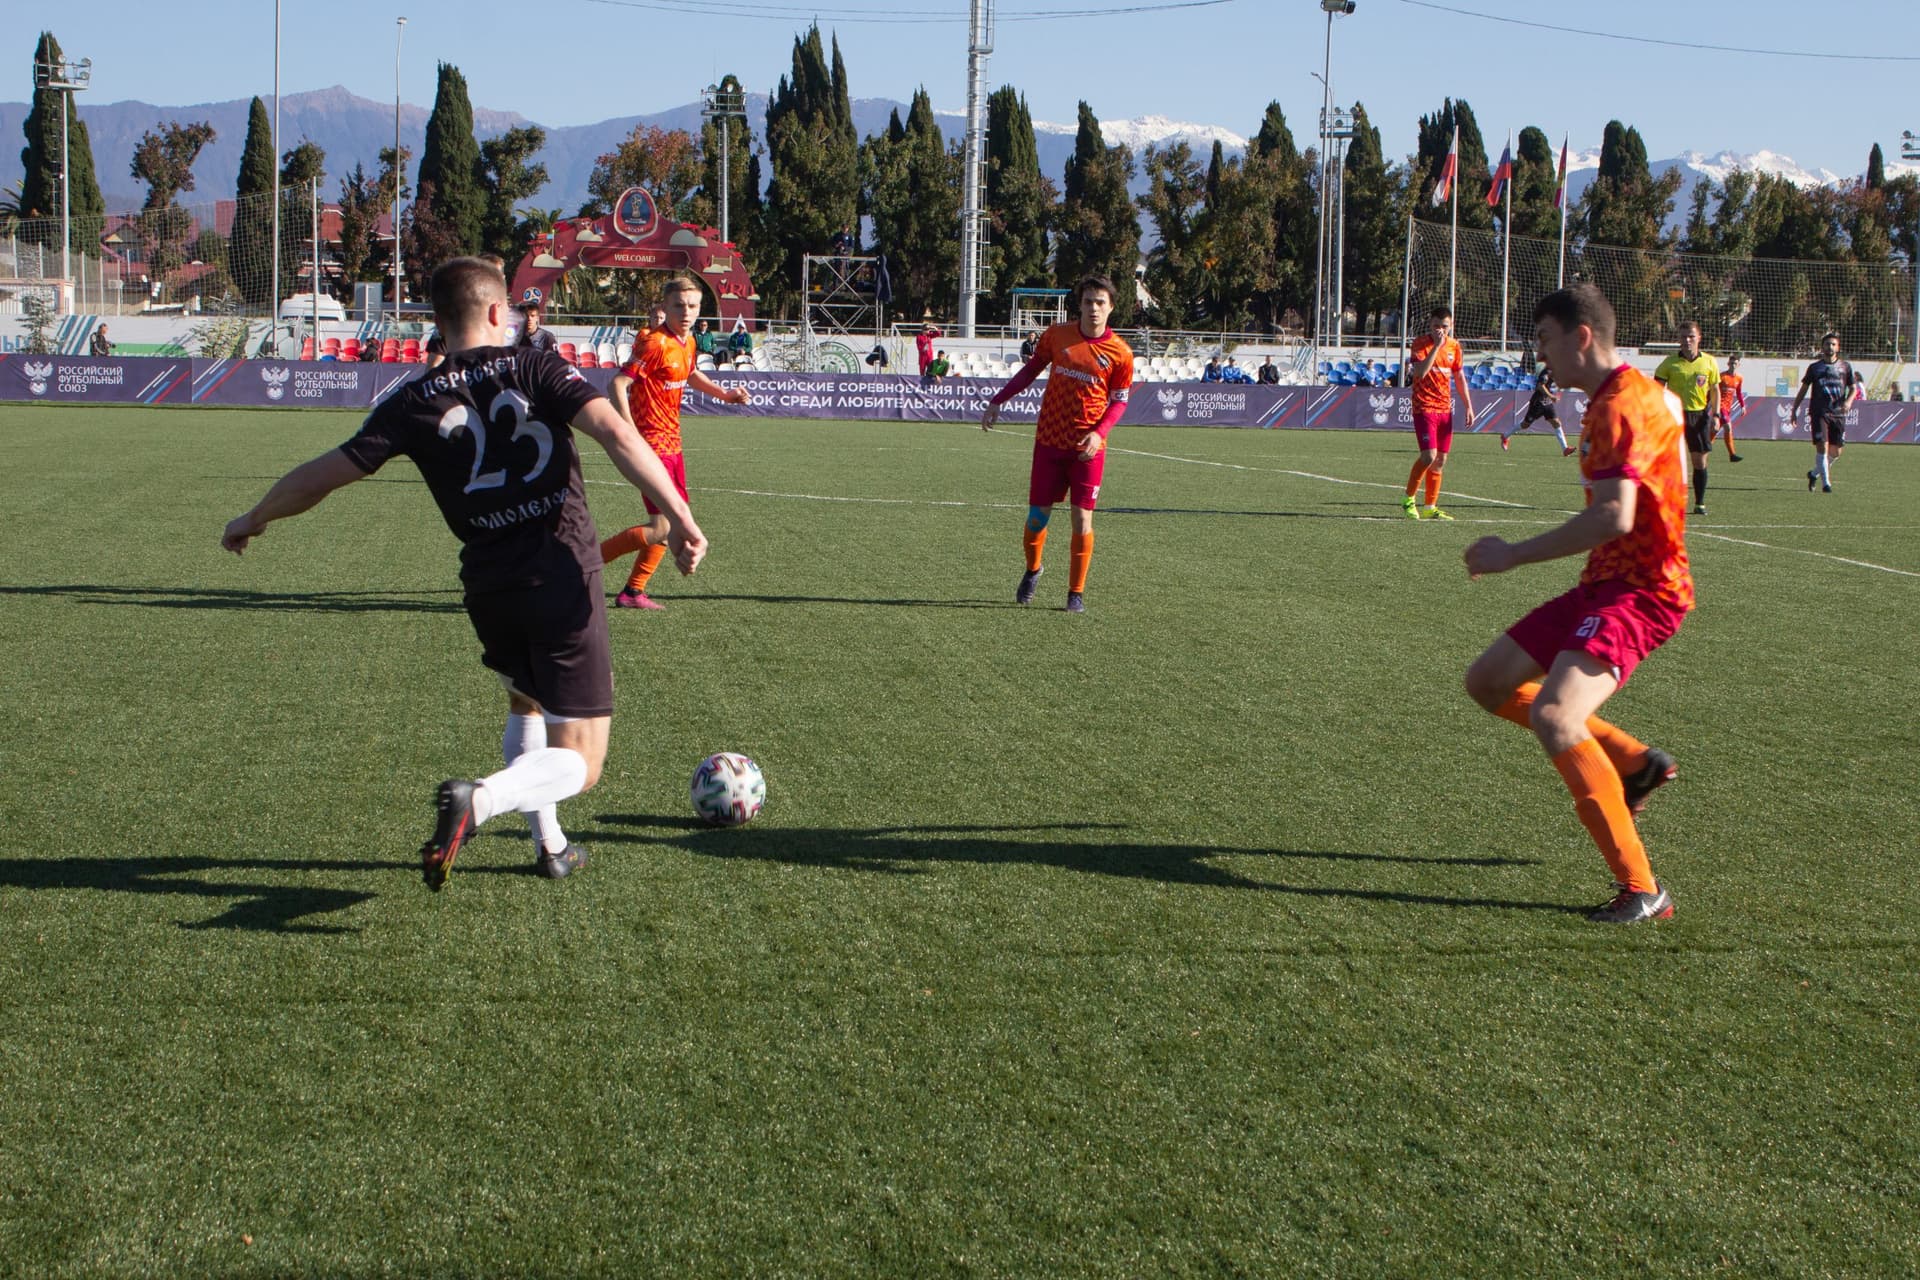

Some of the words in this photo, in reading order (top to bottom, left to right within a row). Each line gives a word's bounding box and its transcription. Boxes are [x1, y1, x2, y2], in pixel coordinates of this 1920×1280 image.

[614, 253, 656, 262] WELCOME!
[58, 365, 123, 375] РОССИЙСКИЙ
[294, 370, 358, 380] РОССИЙСКИЙ
[58, 375, 123, 385] ФУТБОЛЬНЫЙ
[294, 380, 358, 390] ФУТБОЛЬНЫЙ
[58, 385, 87, 393] СОЮЗ
[294, 389, 323, 398] СОЮЗ
[839, 382, 952, 395] СОРЕВНОВАНИЯ
[957, 385, 976, 395] ПО
[981, 386, 1046, 398] ФУОЛУ
[1187, 392, 1246, 402] РОССИЙСКИЙ
[780, 396, 832, 409] СРЕДИ
[837, 397, 965, 411] ЛЮБИТЕЛЬСКИХ
[970, 400, 1041, 415] КОАНД
[1187, 401, 1246, 411] ФУТБОЛЬНЫЙ
[1187, 410, 1213, 418] СОЮЗ
[438, 389, 553, 494] 23
[1575, 616, 1600, 638] 21
